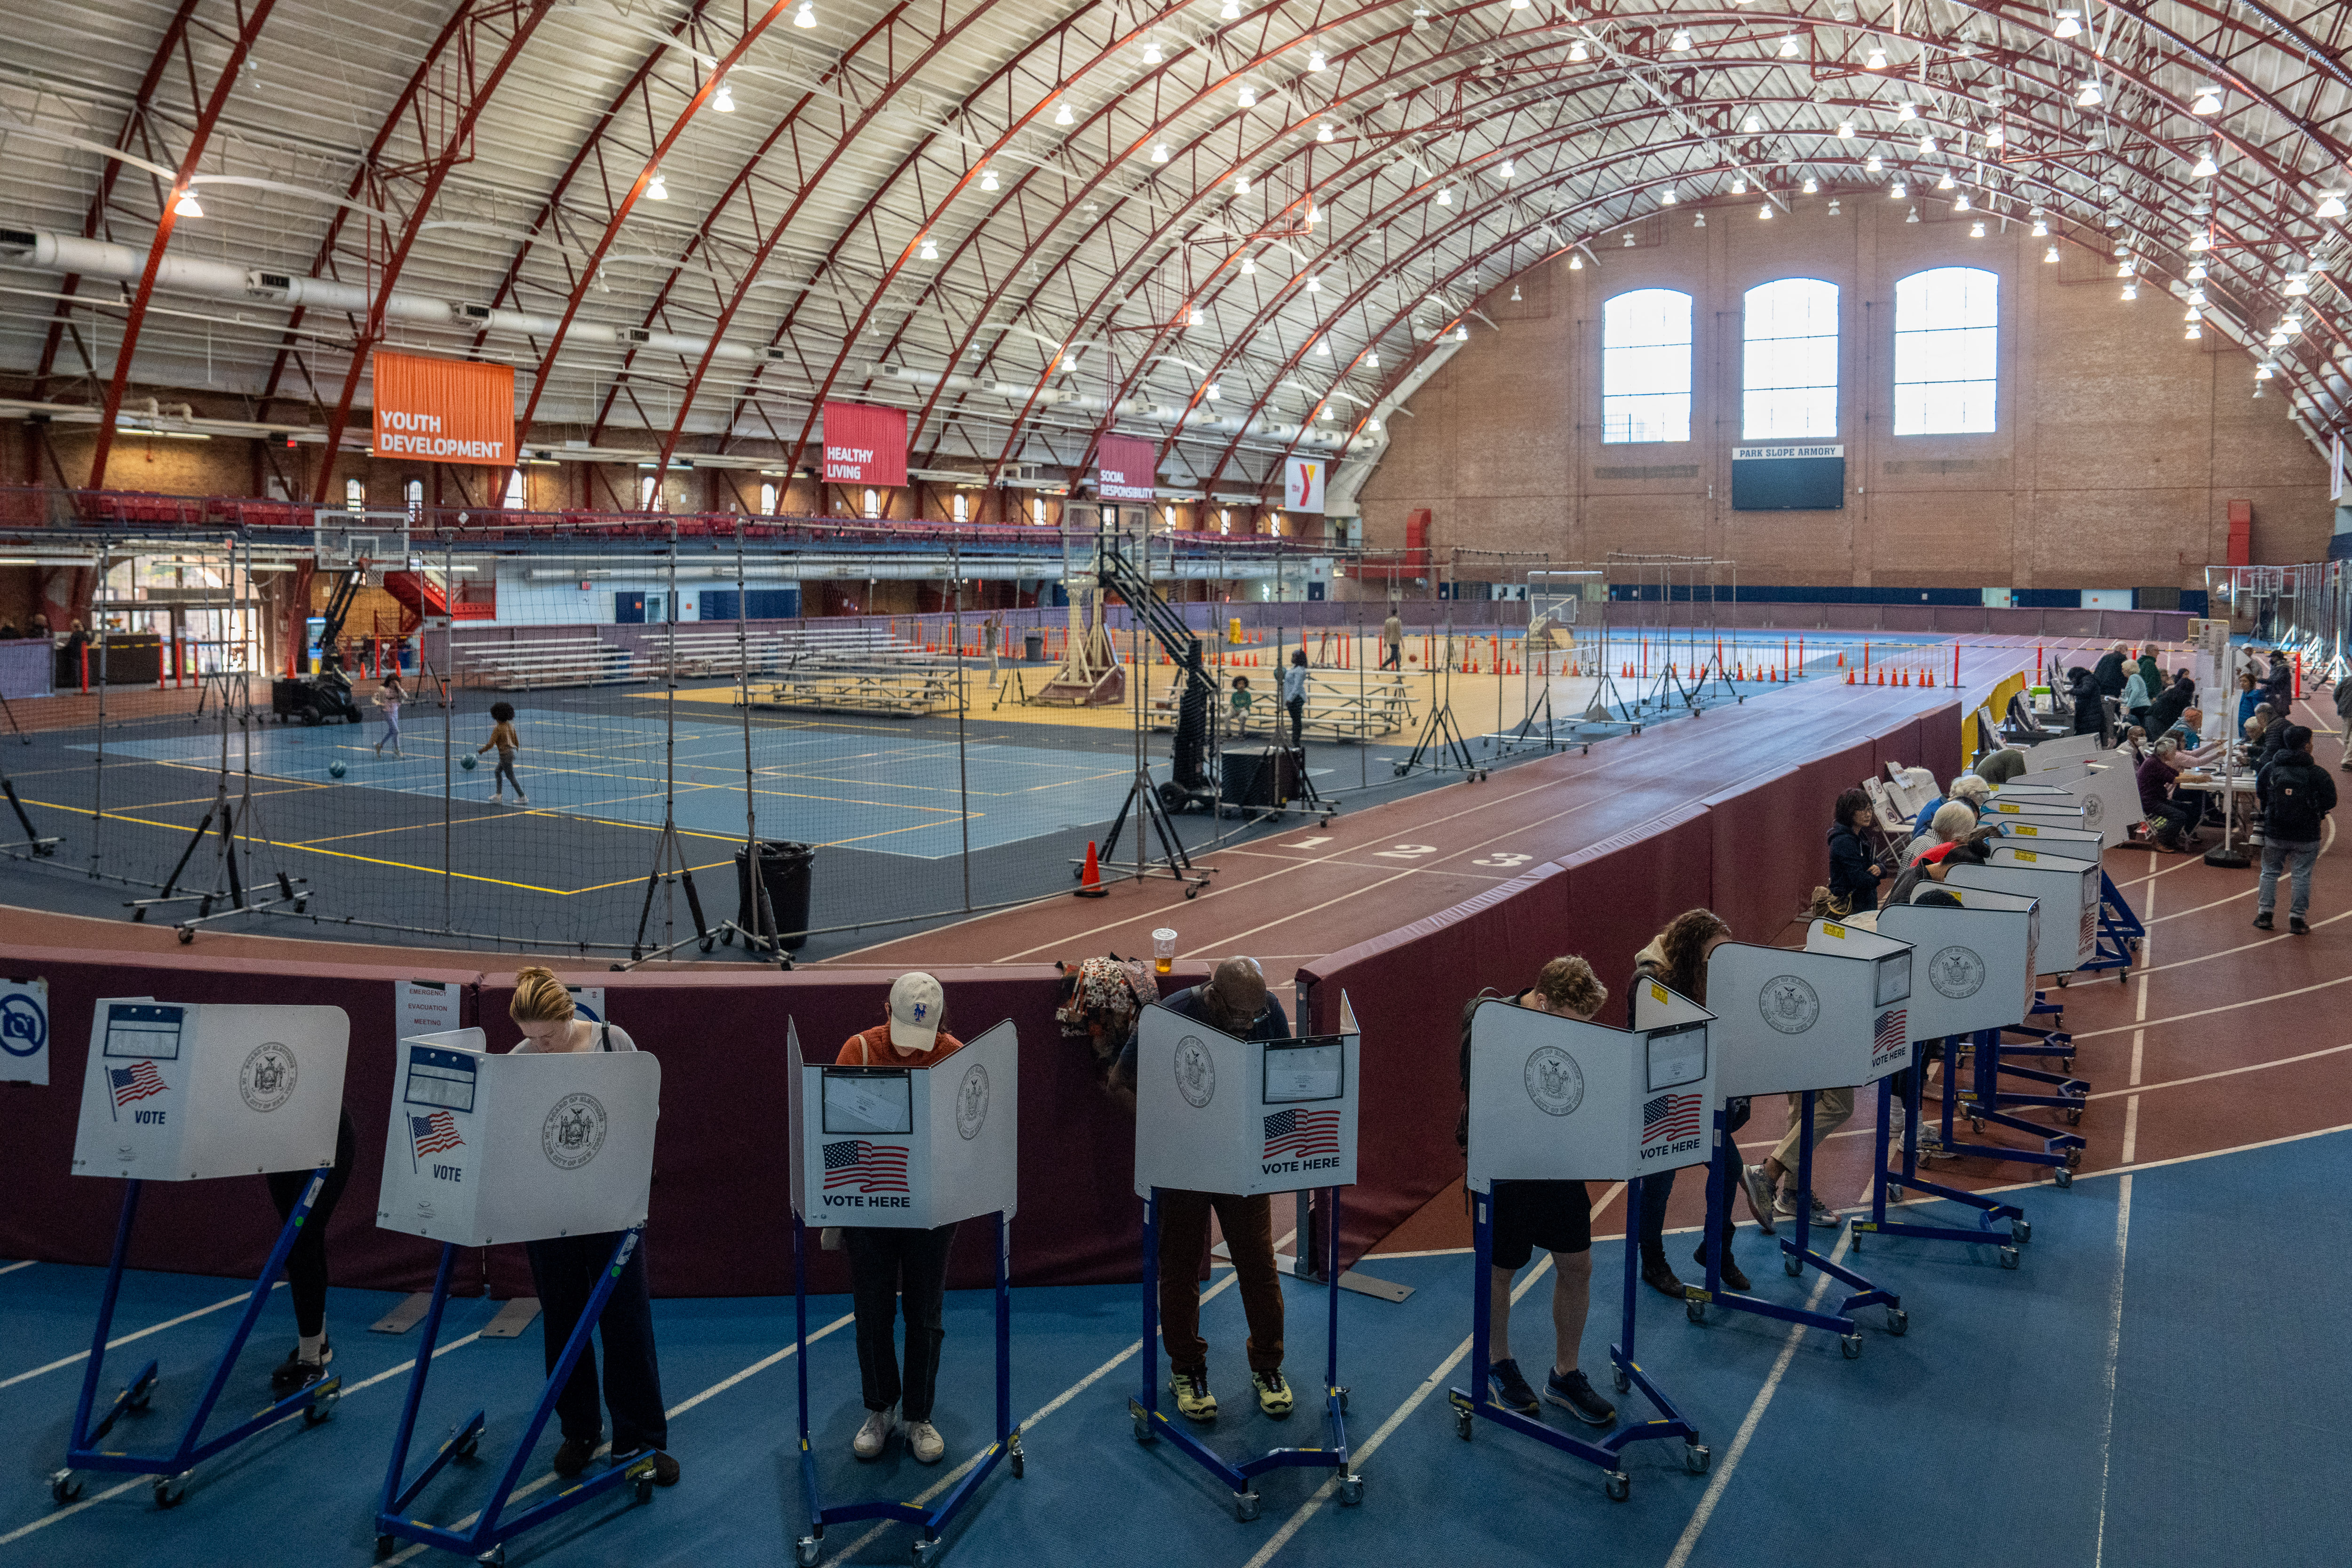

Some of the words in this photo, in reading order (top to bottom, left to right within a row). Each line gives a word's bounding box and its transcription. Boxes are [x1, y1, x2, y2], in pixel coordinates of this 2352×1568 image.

[381, 410, 441, 433] YOUTH
[381, 433, 503, 458] DEVELOPMENT
[1798, 447, 1836, 456] ARMORY
[827, 446, 874, 463] HEALTHY
[827, 464, 861, 480] LIVING
[1100, 470, 1125, 484] SOCIAL
[1100, 484, 1154, 499] RESPONSIBILITY
[1278, 836, 1334, 850] 1
[1372, 844, 1437, 858] 2
[1472, 852, 1533, 867] 3
[409, 988, 446, 997] EMERGENCY
[408, 1003, 447, 1012] EVACUATION
[414, 1018, 441, 1027] MEETING
[1529, 1051, 1543, 1068] BOARD
[1554, 1050, 1580, 1079] ELECTIONS
[1872, 1054, 1888, 1067] VOTE
[1890, 1047, 1906, 1060] HERE
[1536, 1098, 1549, 1110] CITY
[1560, 1104, 1573, 1113] NEW
[1572, 1087, 1581, 1105] YORK
[135, 1111, 166, 1124] VOTE
[548, 1100, 568, 1122] BOARD
[580, 1097, 604, 1122] ELECTIONS
[553, 1154, 567, 1165] CITY
[578, 1151, 592, 1164] NEW
[592, 1131, 603, 1151] YORK
[1640, 1145, 1669, 1160] VOTE
[1672, 1138, 1700, 1153] HERE
[434, 1164, 461, 1182] VOTE
[1262, 1161, 1299, 1174] VOTE
[1303, 1157, 1340, 1170] HERE
[822, 1195, 864, 1207] VOTE
[869, 1196, 911, 1207] HERE
